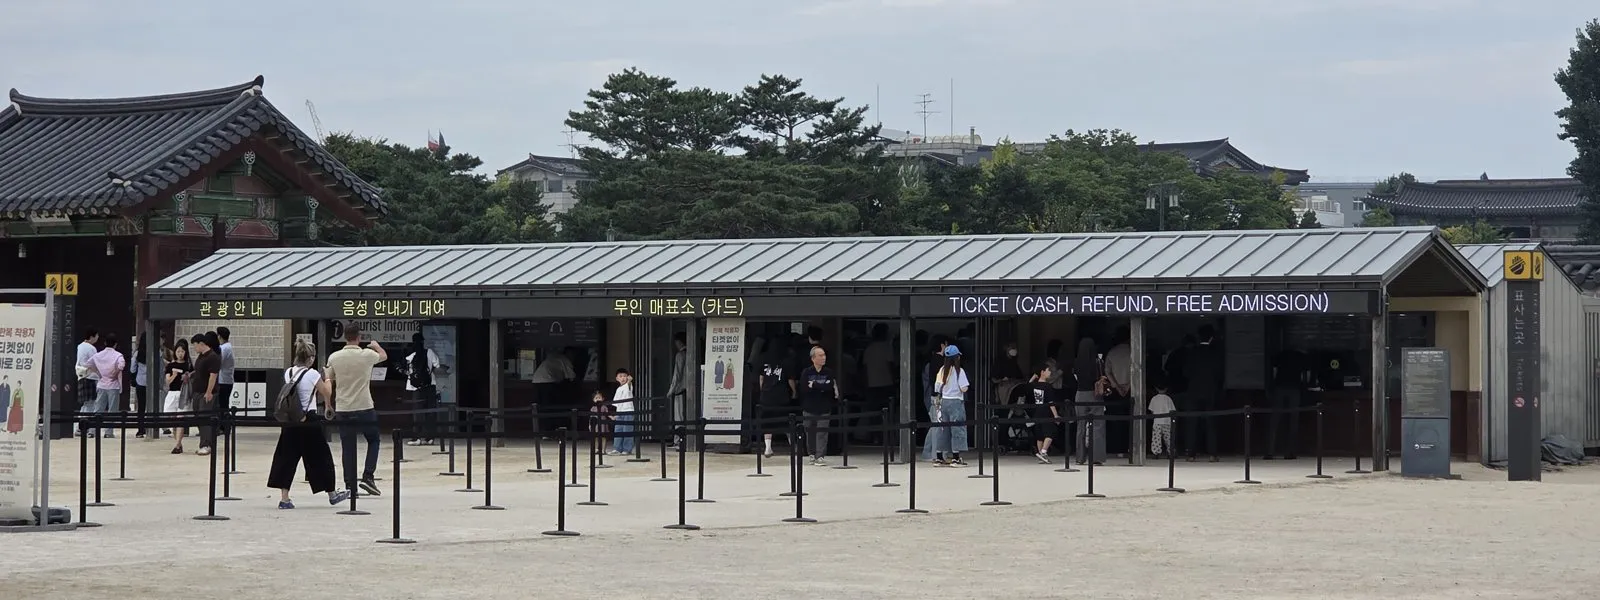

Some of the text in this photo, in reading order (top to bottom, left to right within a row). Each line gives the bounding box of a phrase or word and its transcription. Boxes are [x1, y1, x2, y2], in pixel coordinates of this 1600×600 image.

[342, 299, 446, 316] 음성 안내기 대여
[614, 297, 744, 316] 무인 매표소 (카드)
[949, 292, 1329, 314] TICKET (CASH, REFUND, FREE ADMISSION)
[65, 304, 73, 345] TICKETS
[348, 319, 381, 332] urist
[15, 328, 35, 338] 착용자
[0, 342, 34, 354] 티켓없이
[16, 358, 33, 370] 입장
